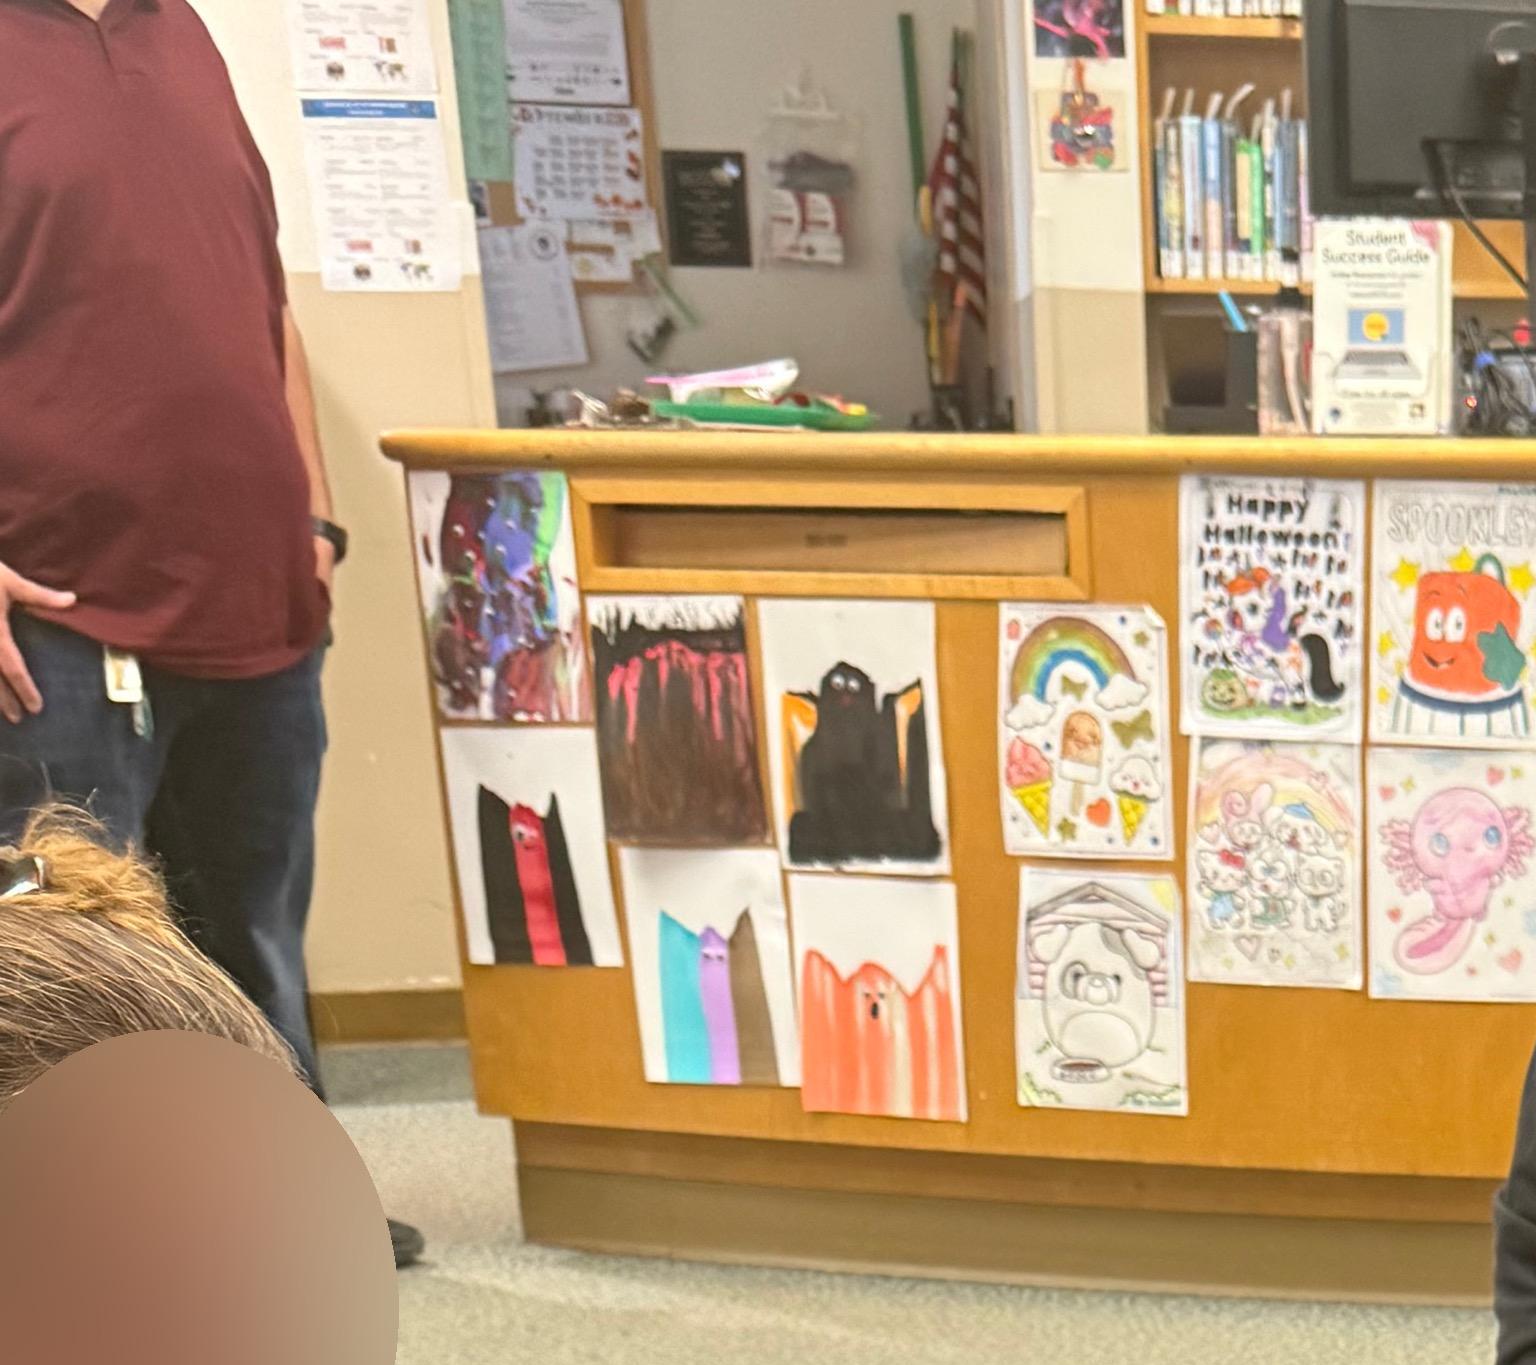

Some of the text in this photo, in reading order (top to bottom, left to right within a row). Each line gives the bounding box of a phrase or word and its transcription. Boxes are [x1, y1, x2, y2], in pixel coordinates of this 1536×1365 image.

[1345, 230, 1407, 246] Student
[1322, 248, 1430, 264] Success Guide
[1227, 493, 1309, 523] Happy
[1204, 523, 1338, 550] Halloween
